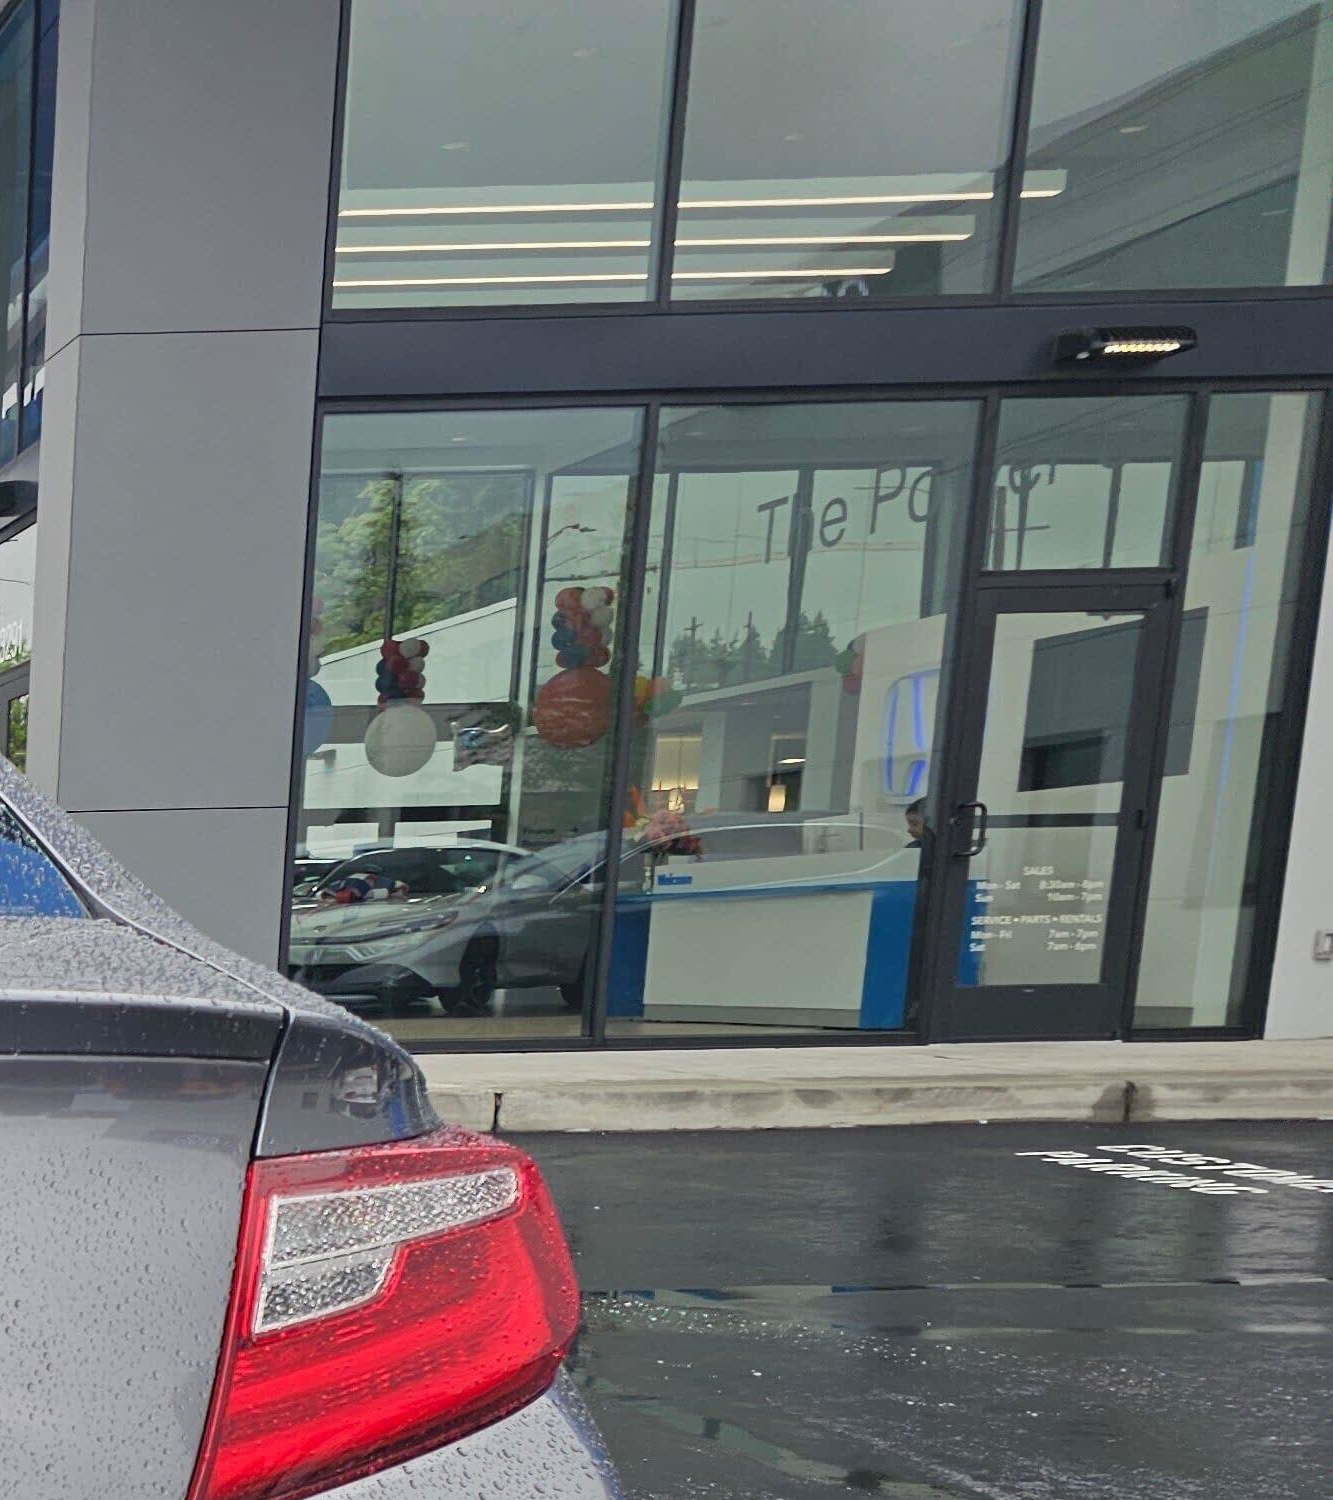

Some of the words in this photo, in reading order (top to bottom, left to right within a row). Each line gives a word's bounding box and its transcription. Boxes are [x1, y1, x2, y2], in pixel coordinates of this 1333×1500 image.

[757, 491, 847, 564] Te
[1023, 866, 1054, 875] SALES
[971, 915, 1012, 925] SERVICE
[1020, 914, 1051, 924] PARTS
[1059, 914, 1104, 924] RENTALS
